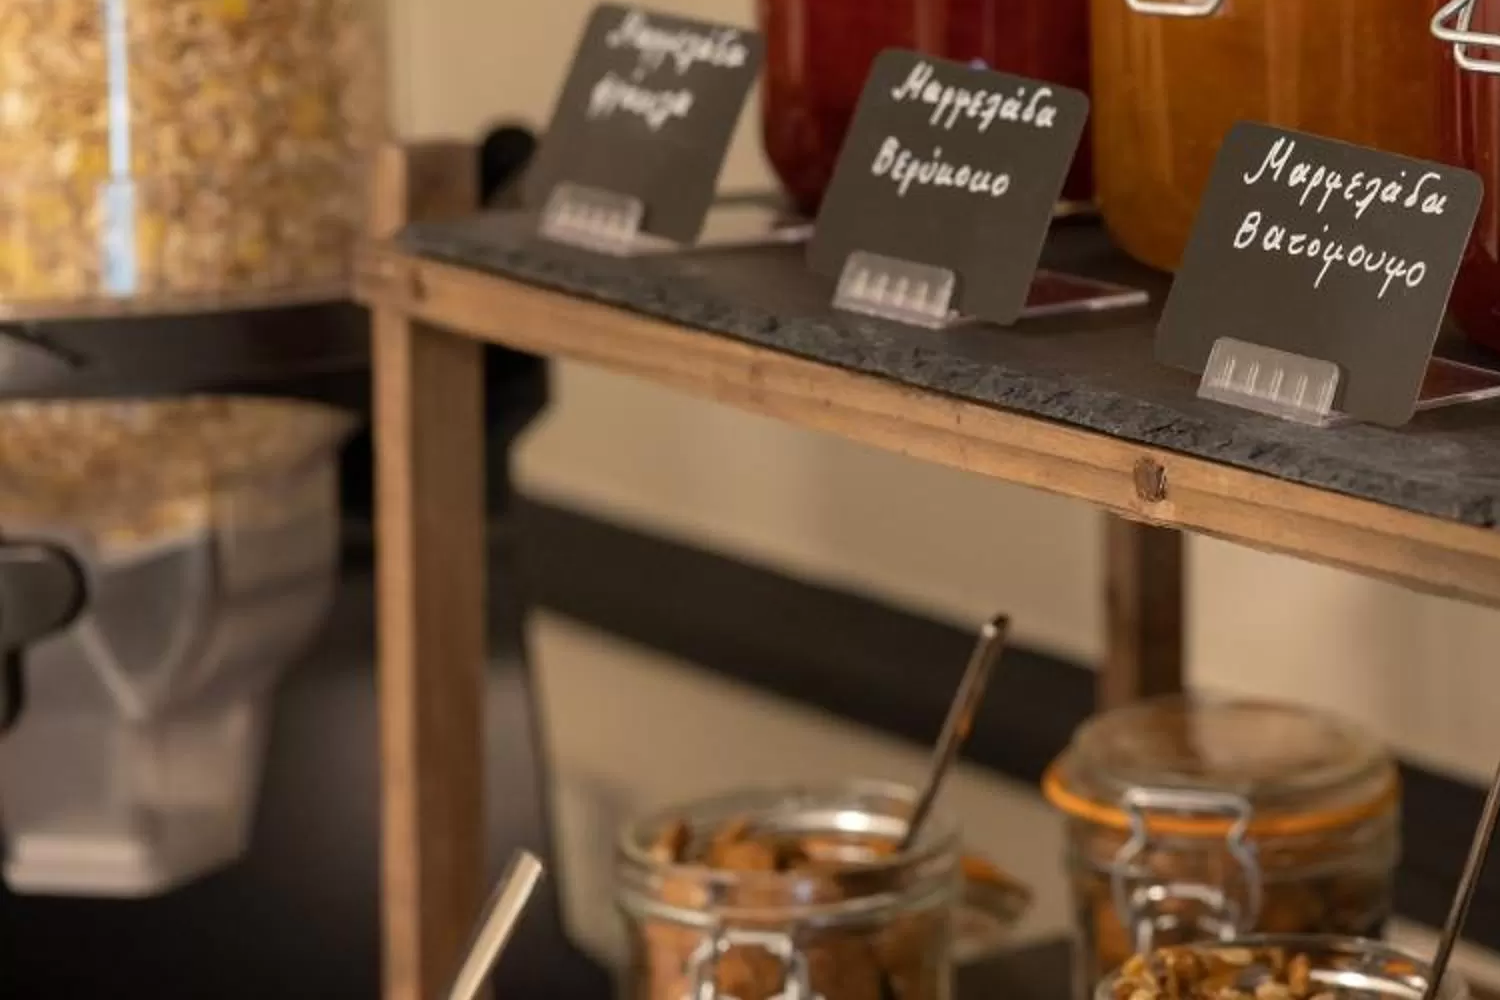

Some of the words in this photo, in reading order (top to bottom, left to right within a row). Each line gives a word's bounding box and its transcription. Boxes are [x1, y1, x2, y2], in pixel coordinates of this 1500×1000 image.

[890, 60, 1058, 133] Μαρμελάδα
[871, 135, 1011, 198] Βερύκοκο
[1243, 135, 1448, 220] Μαρμελάδα
